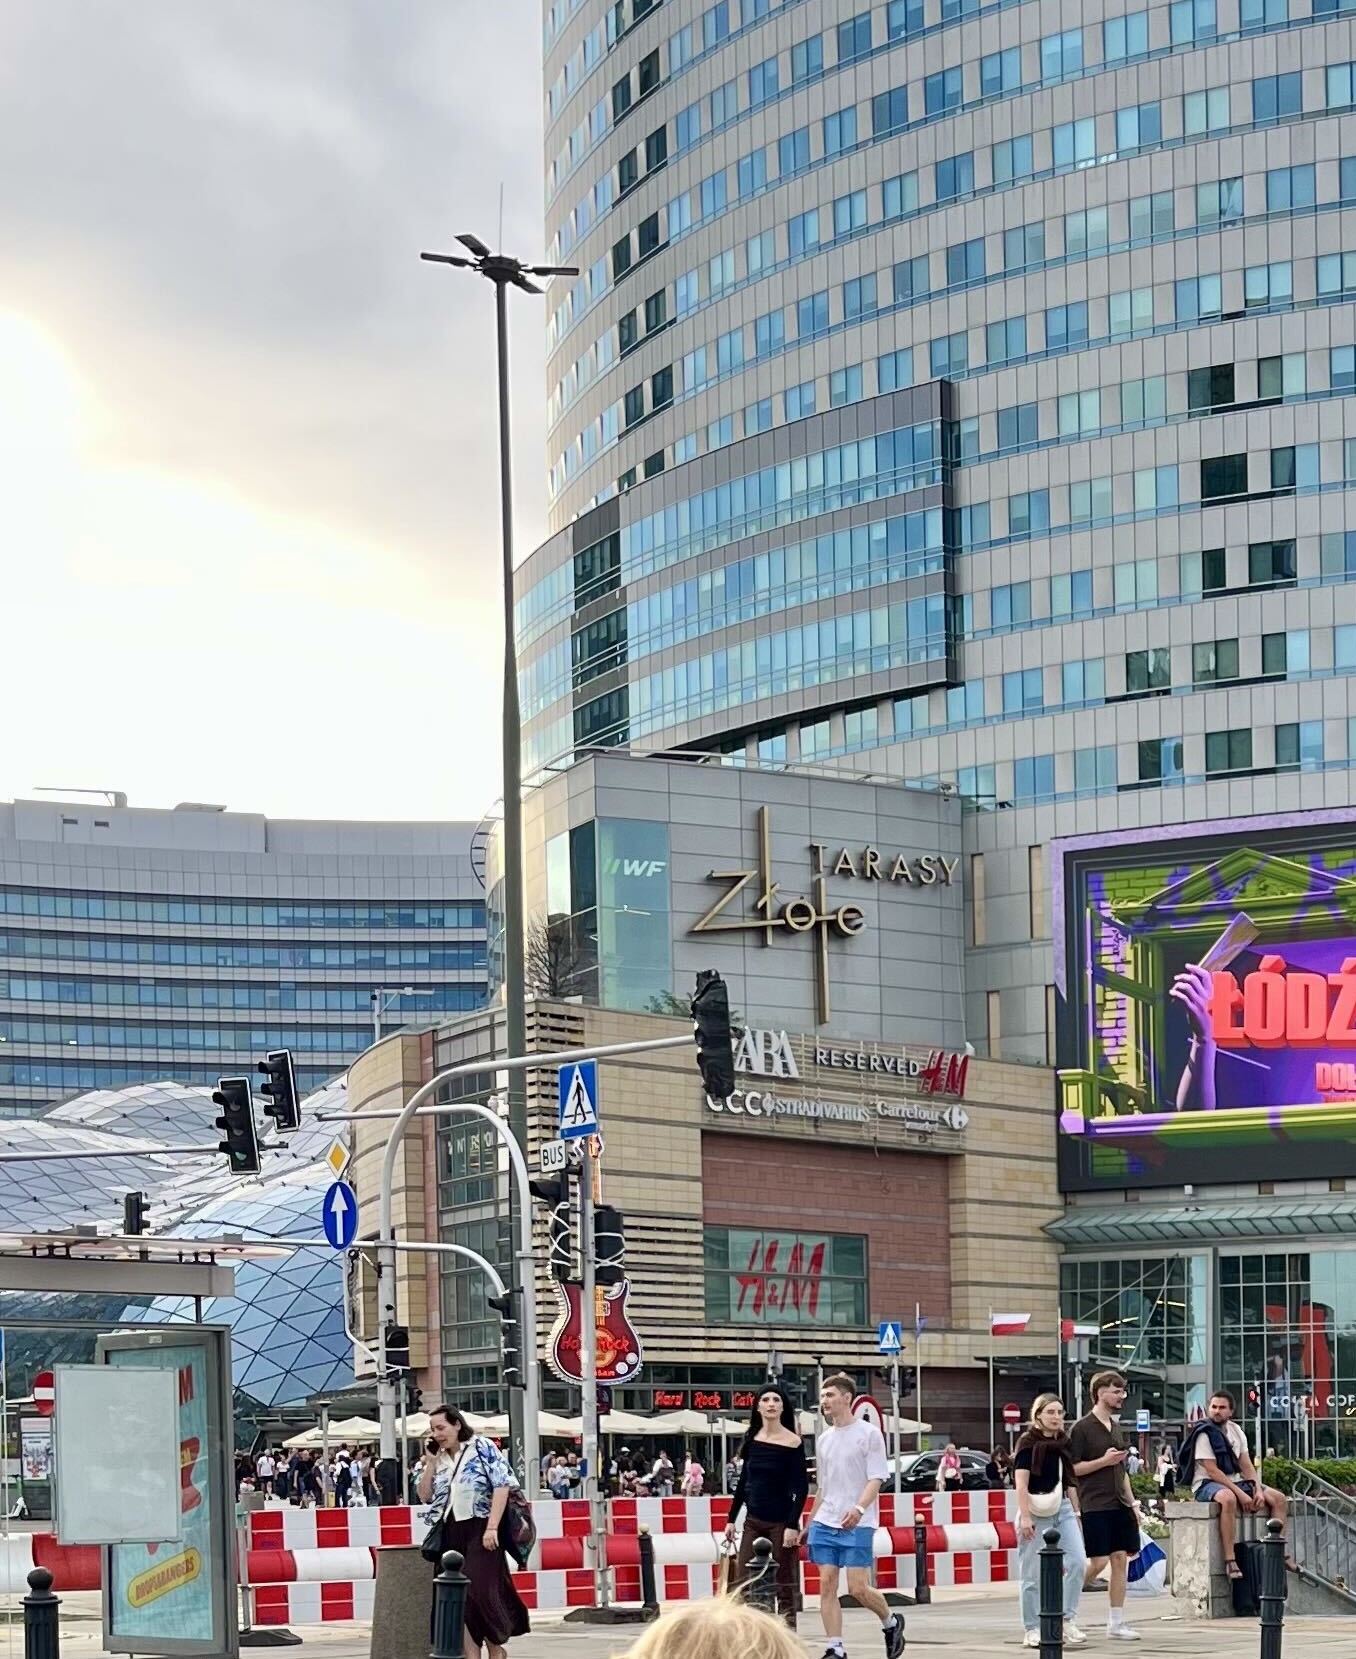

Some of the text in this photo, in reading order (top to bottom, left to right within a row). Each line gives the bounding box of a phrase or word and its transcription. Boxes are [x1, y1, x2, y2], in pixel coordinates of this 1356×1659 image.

[810, 843, 959, 886] TARASY
[688, 805, 866, 1024] Złote
[732, 1026, 799, 1077] ARA
[816, 1048, 920, 1077] RESERVED
[707, 1089, 762, 1116] CCC
[776, 1098, 870, 1122] STRADIVARIUS
[877, 1101, 941, 1121] Carrefour
[543, 1145, 564, 1167] BUS
[736, 1239, 825, 1319] H&M
[655, 1391, 684, 1406] Hard
[694, 1391, 721, 1408] Rock
